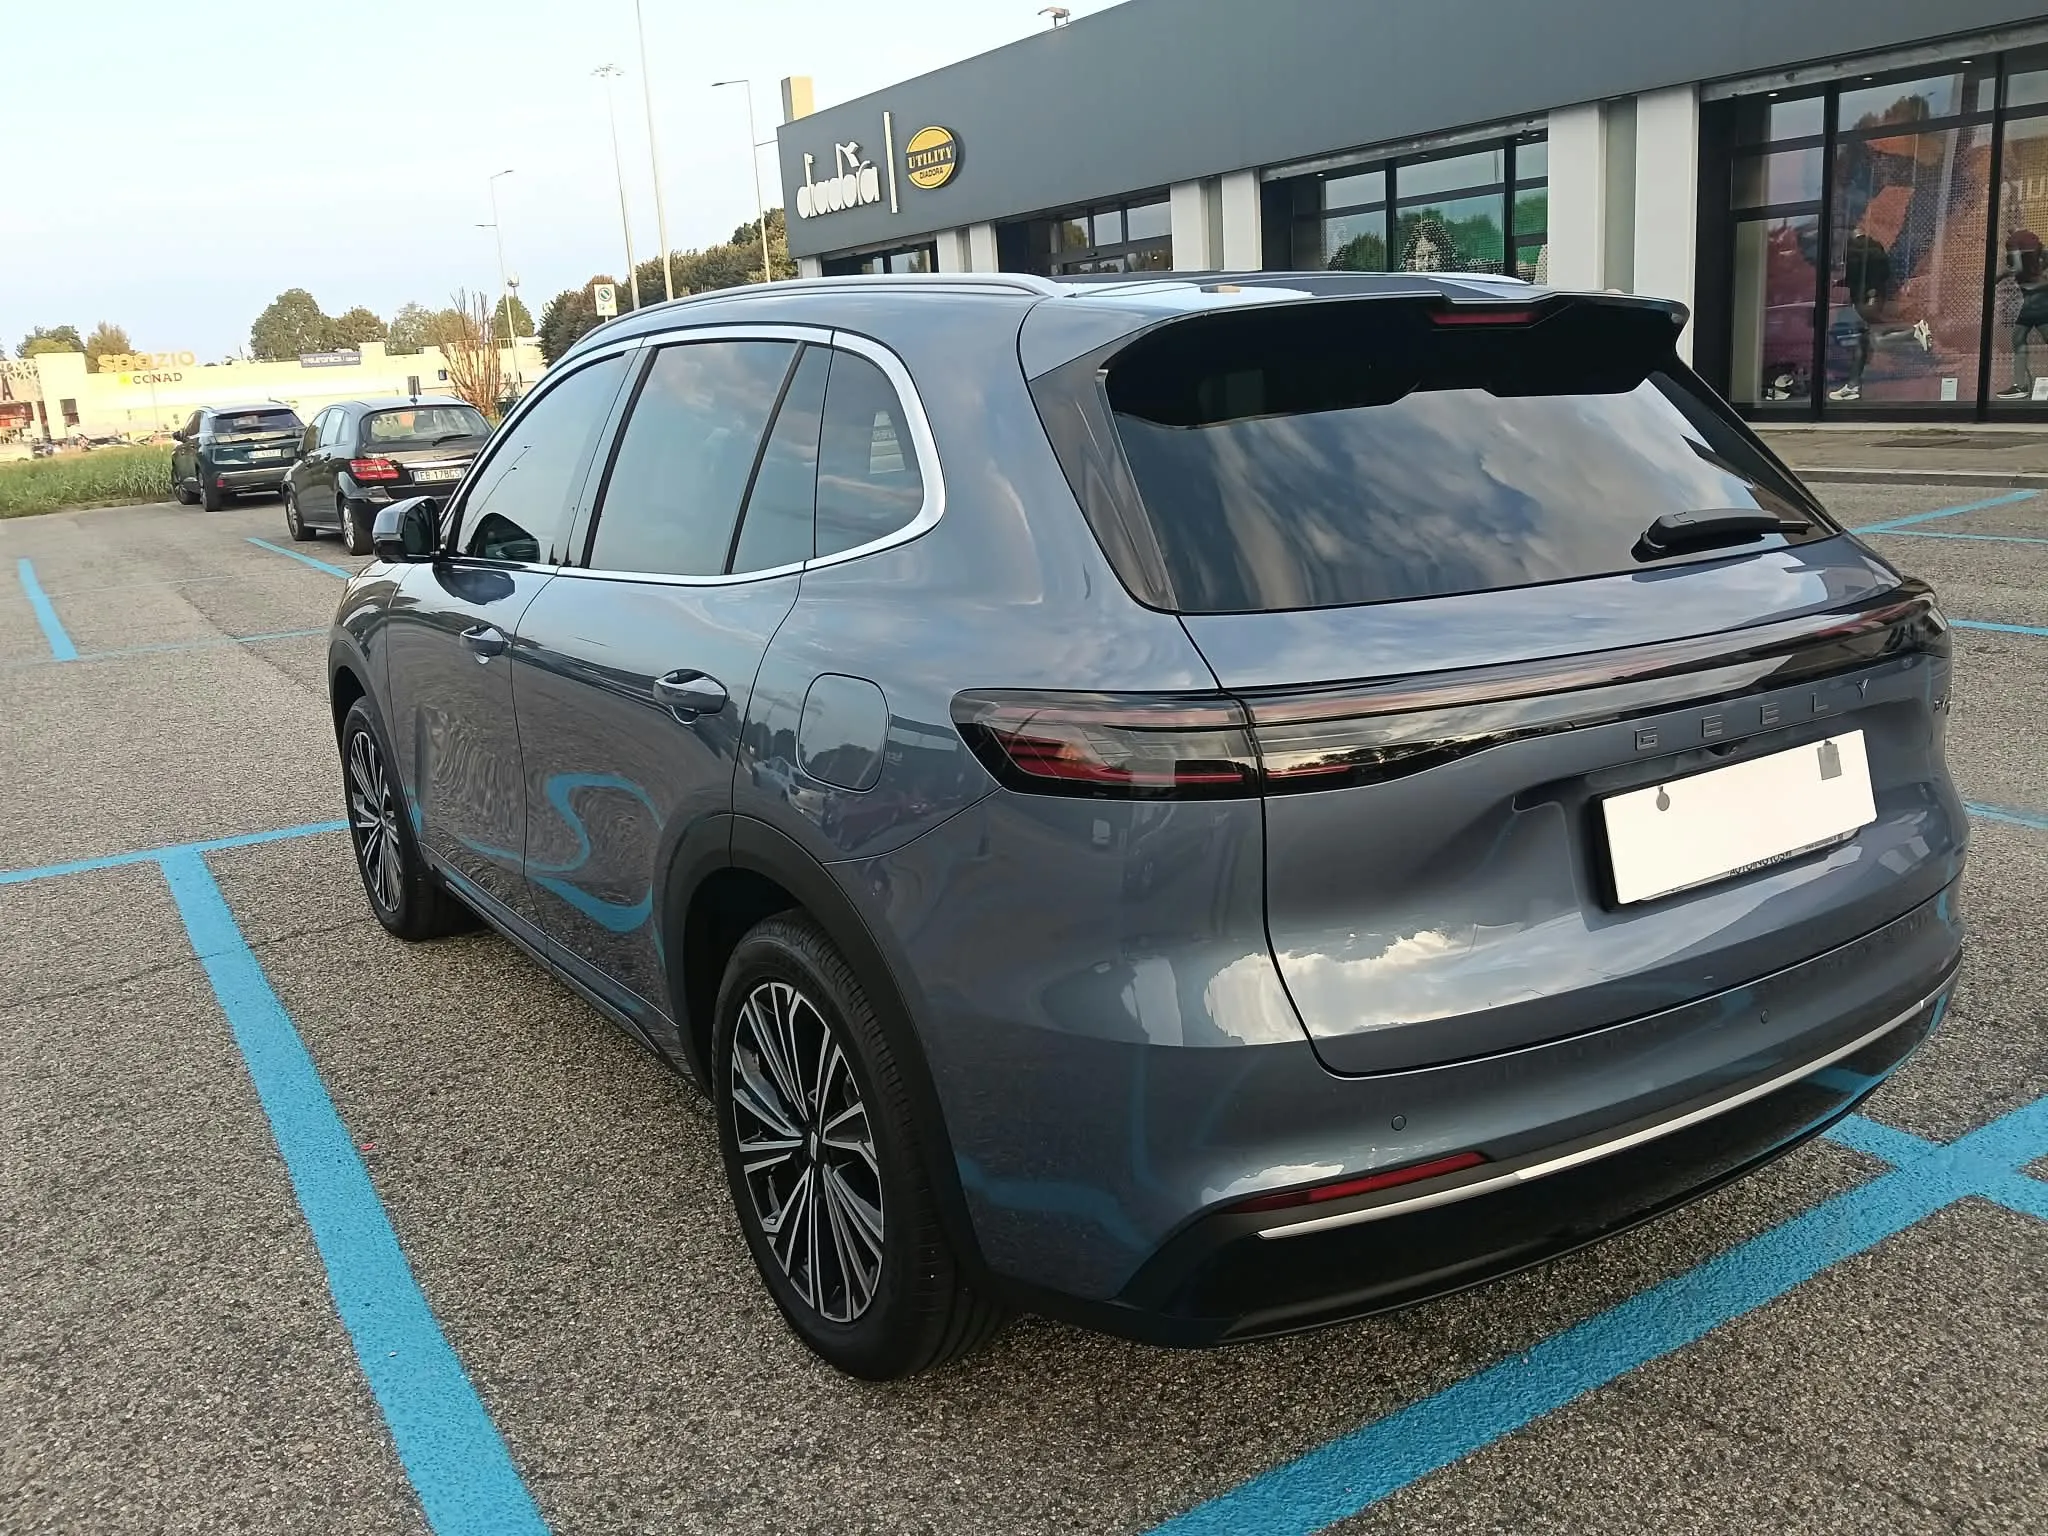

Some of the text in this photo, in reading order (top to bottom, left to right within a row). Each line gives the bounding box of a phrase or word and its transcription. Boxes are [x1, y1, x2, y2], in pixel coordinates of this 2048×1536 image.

[797, 141, 880, 219] diadora
[908, 146, 952, 169] UTILITY
[919, 167, 944, 179] DIADORA
[1635, 679, 1870, 750] GEELY
